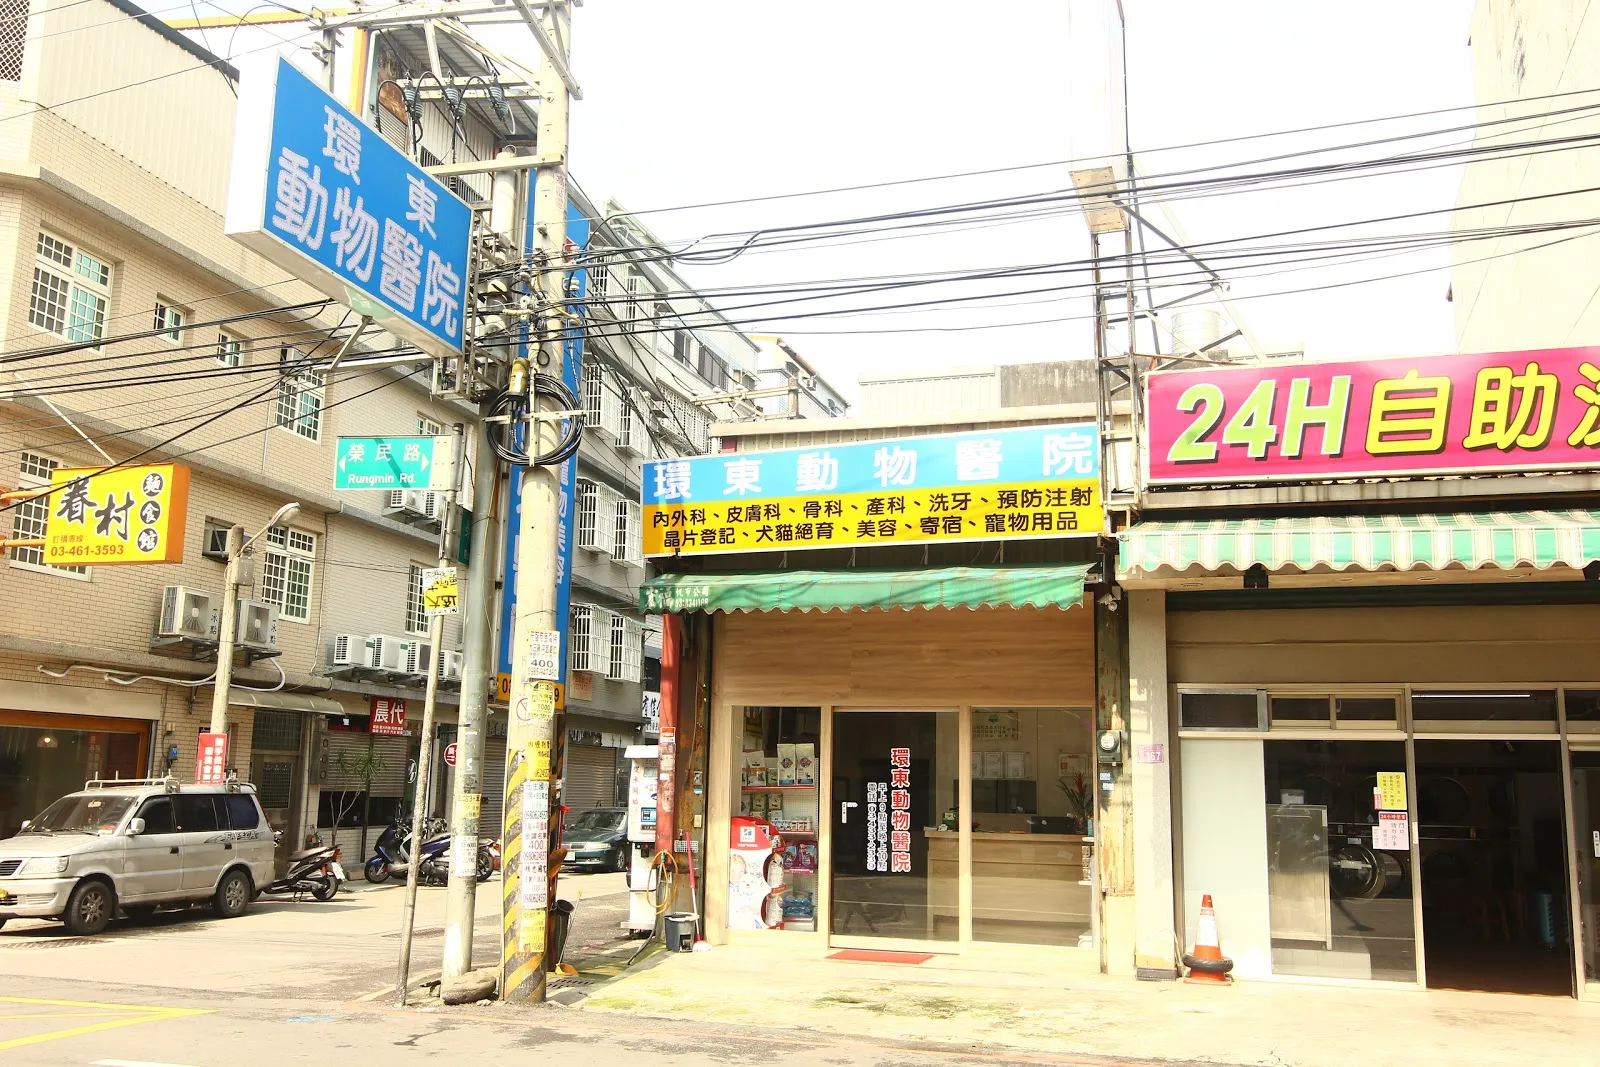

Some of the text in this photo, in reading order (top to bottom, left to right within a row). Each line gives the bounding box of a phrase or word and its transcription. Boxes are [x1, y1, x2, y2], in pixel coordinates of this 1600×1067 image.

[271, 146, 462, 340] 動物醫院
[1166, 374, 1353, 463] 24H
[347, 442, 421, 463] 榮民路
[653, 432, 1095, 501] 環東動物醫院
[347, 472, 416, 486] Rungmin Rd.
[50, 544, 124, 557] 03-461-3593
[530, 660, 554, 668] 400
[1145, 751, 1161, 762] 167
[890, 746, 911, 873] 環東動物醫院
[528, 840, 544, 850] 400
